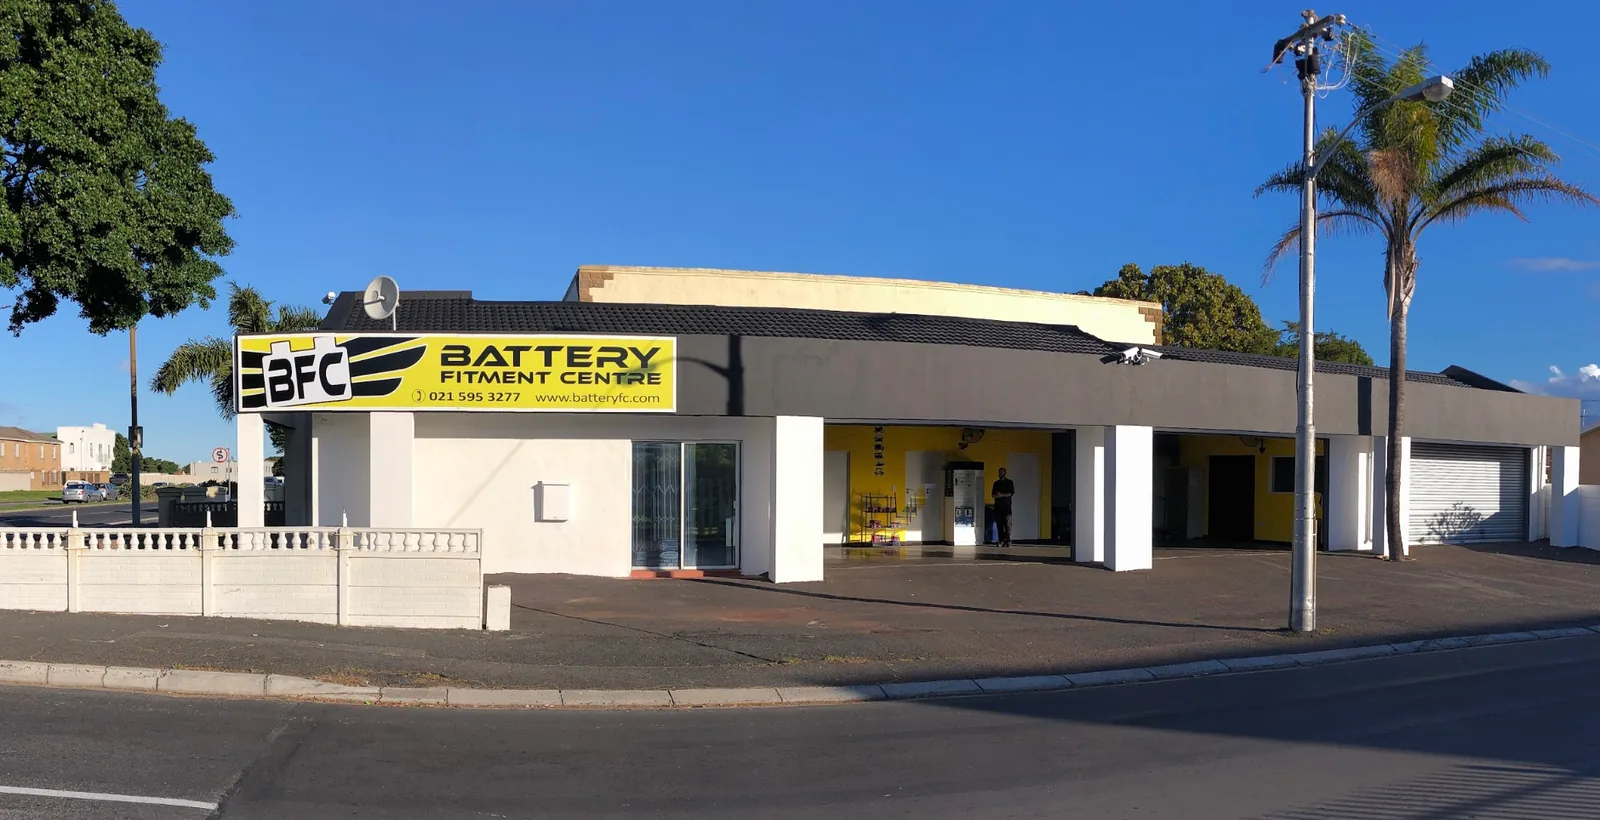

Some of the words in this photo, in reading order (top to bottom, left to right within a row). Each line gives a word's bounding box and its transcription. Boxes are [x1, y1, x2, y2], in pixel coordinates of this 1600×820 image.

[441, 345, 661, 368] BATTERY
[267, 351, 348, 403] BFC
[440, 370, 552, 385] FITMENT
[560, 371, 662, 386] CENTRE
[429, 391, 454, 403] 021
[457, 391, 484, 403] 595
[487, 391, 522, 403] 3277
[534, 392, 661, 406] www.batteryfc.com
